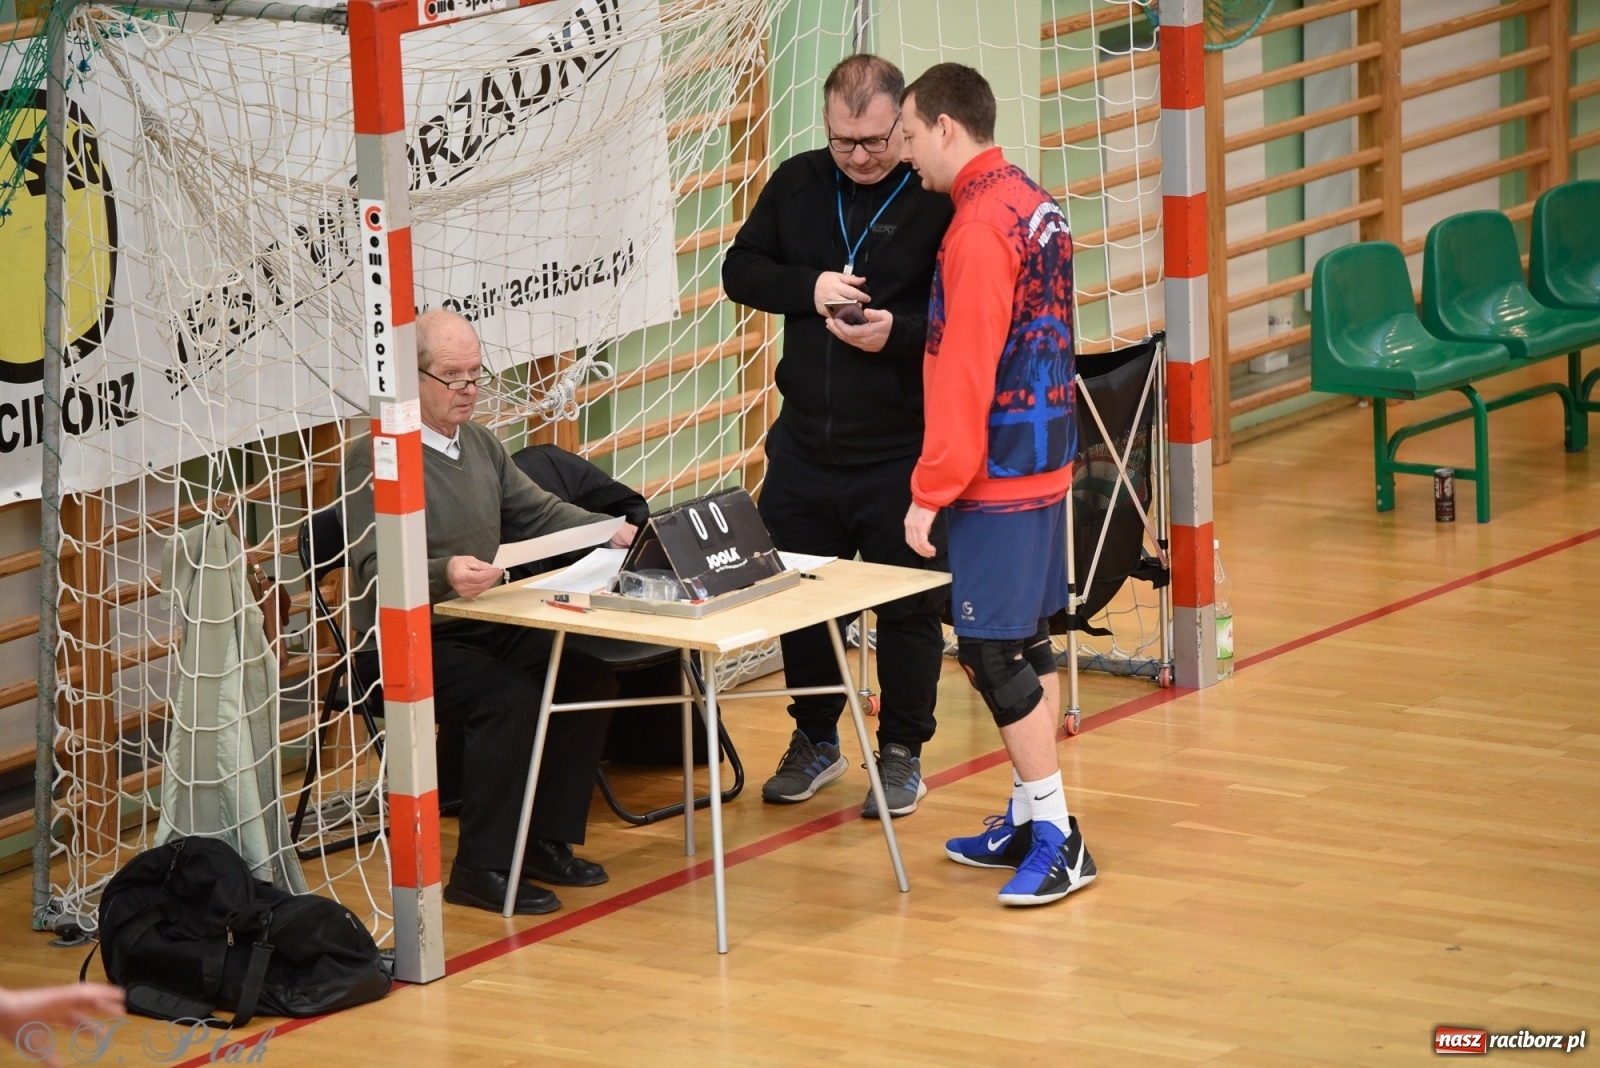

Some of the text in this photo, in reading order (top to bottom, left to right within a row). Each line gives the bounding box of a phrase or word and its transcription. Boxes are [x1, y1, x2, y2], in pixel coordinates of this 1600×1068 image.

[373, 303, 386, 392] sport
[689, 501, 729, 540] 0 0
[706, 547, 741, 569] JOOLA
